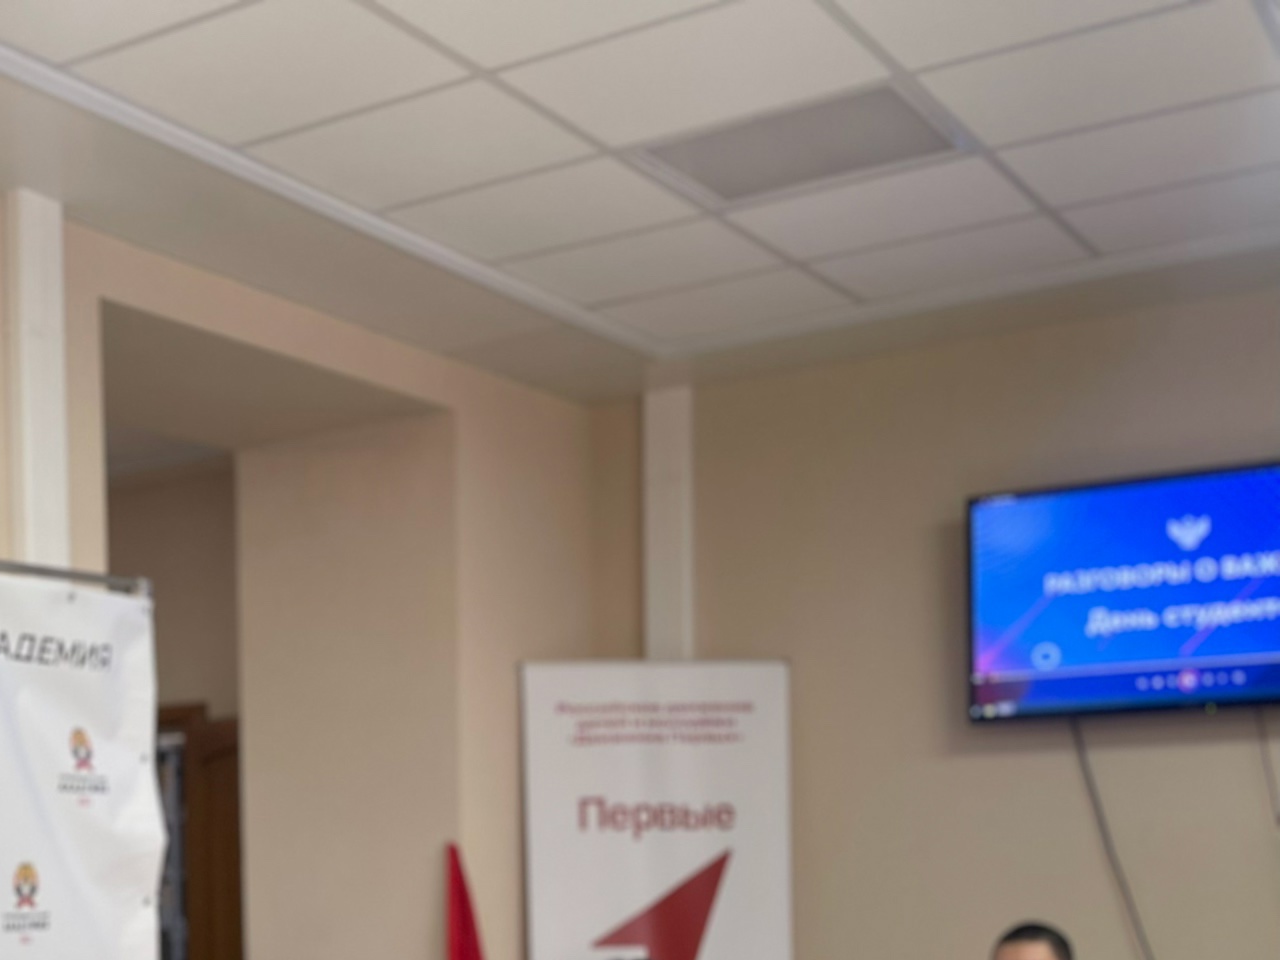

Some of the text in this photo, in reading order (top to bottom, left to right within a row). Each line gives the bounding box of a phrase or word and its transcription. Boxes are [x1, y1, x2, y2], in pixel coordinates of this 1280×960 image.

[1194, 556, 1218, 583] О
[1085, 606, 1159, 638] День
[577, 796, 736, 840] Первые
